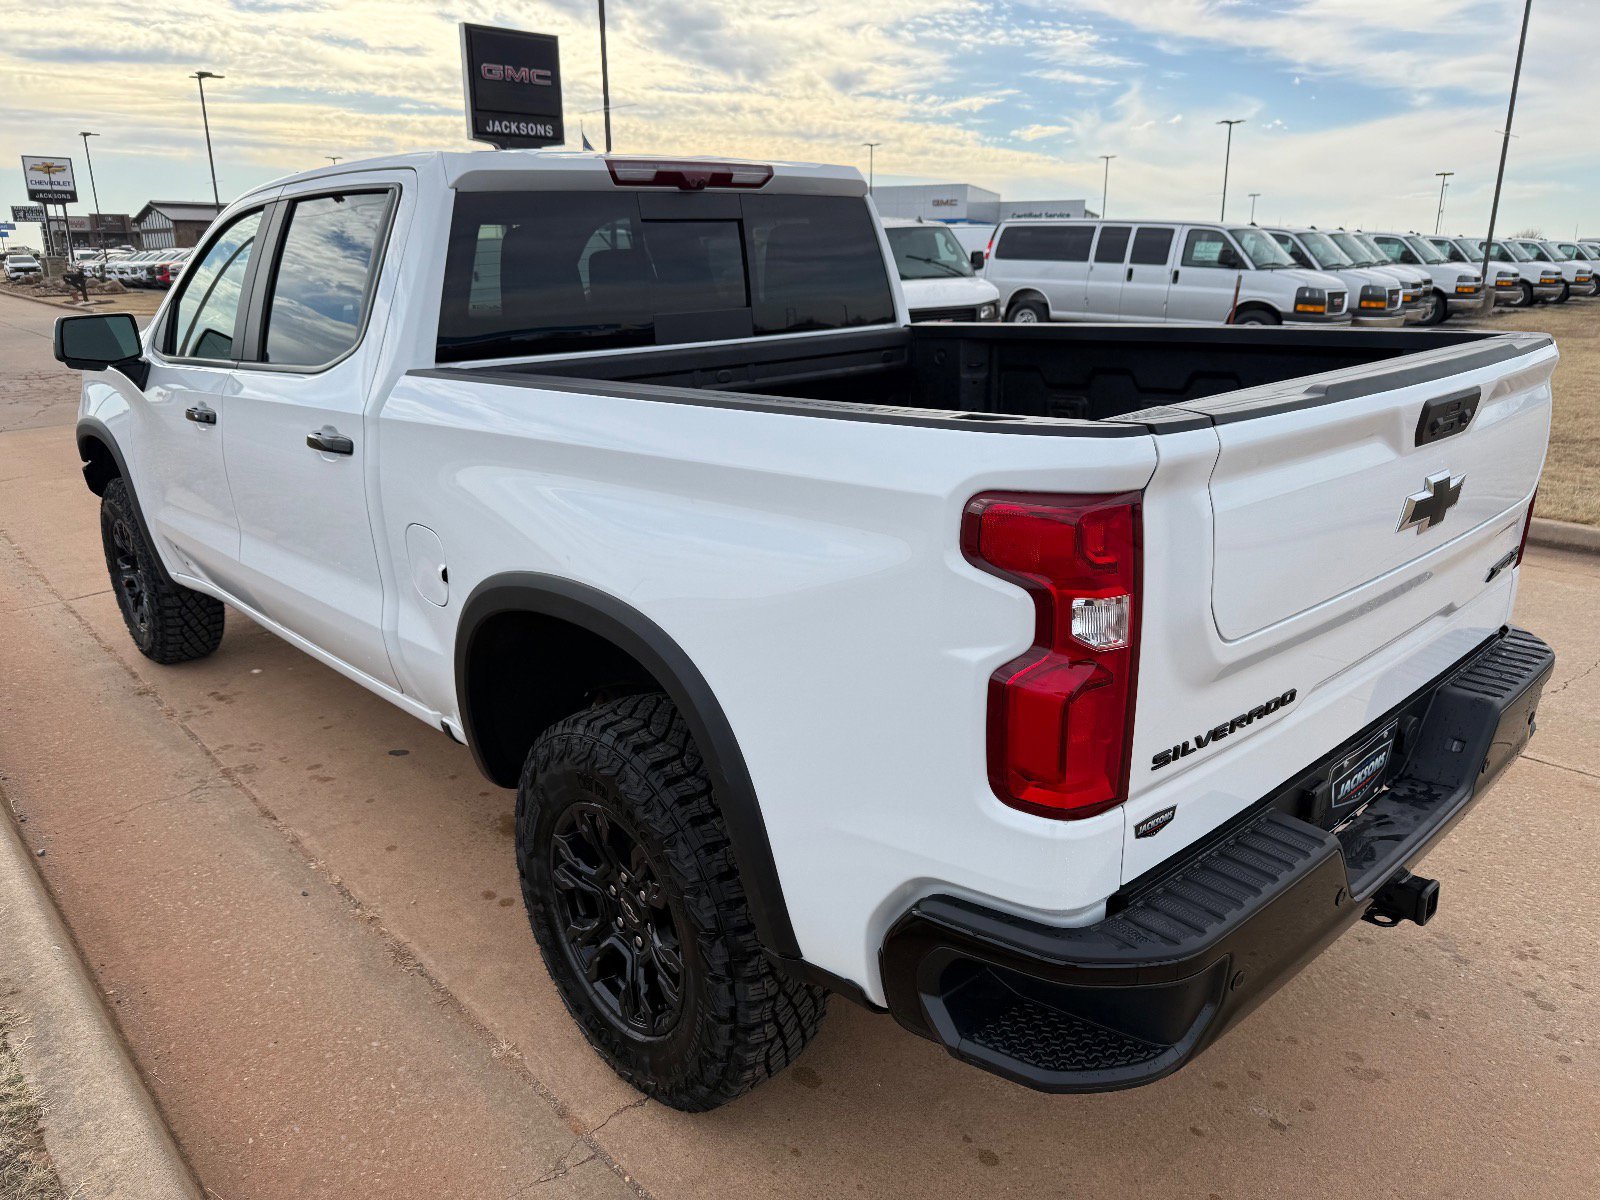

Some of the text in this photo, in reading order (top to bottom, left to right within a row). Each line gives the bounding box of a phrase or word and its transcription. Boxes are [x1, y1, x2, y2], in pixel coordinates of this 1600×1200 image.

[481, 63, 552, 86] GMC
[486, 120, 554, 137] JACKSONS
[932, 199, 958, 207] GMC
[1011, 211, 1071, 219] Certified Service
[1151, 688, 1297, 771] SILVERADO
[1337, 751, 1387, 799] JACKSONS
[1138, 809, 1174, 834] JACKSONS
